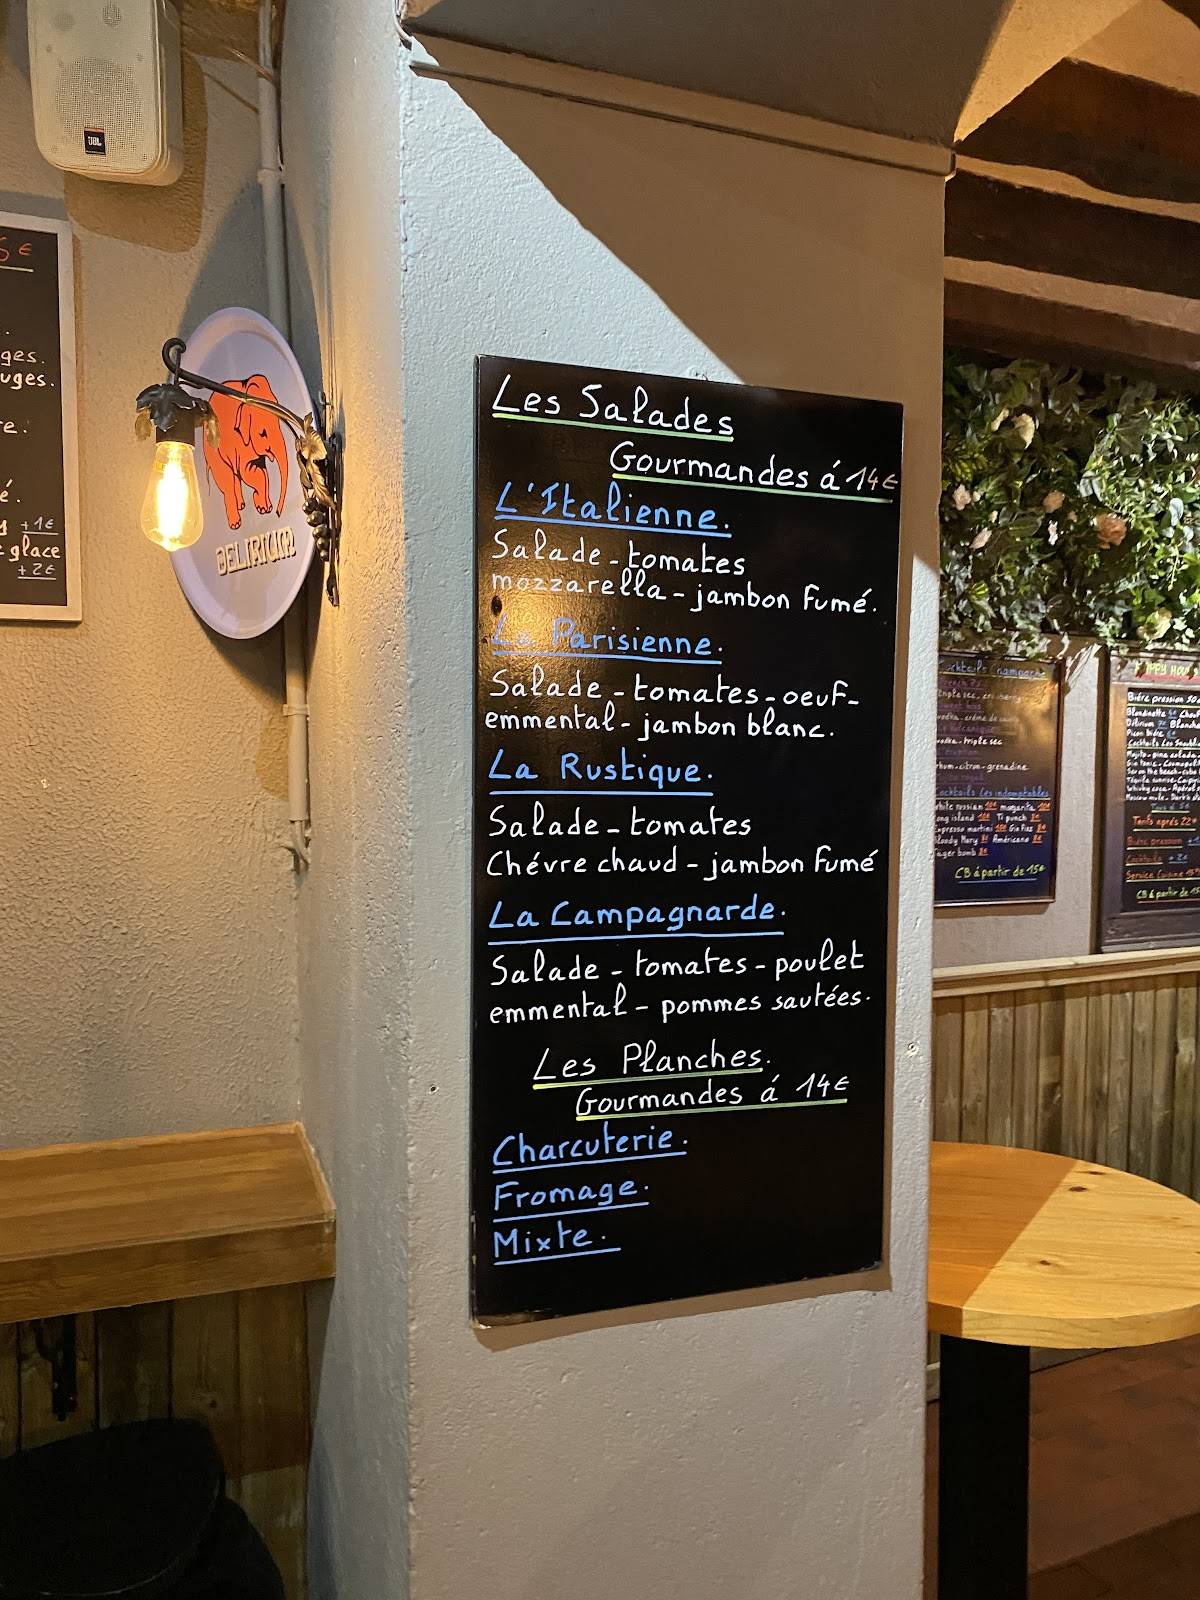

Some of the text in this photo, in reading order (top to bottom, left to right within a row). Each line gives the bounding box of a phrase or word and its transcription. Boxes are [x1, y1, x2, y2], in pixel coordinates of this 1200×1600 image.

[87, 136, 103, 147] JBL
[492, 373, 736, 437] Les Salades
[610, 441, 809, 490] Gourmandes
[846, 467, 898, 492] 14€
[495, 482, 731, 531] L'Italienne.
[9, 534, 61, 562] glace
[214, 525, 297, 577] DELIRIUM
[491, 528, 746, 577] Salade tomates
[491, 566, 668, 602] mozzarella
[689, 583, 791, 613] jambon
[552, 617, 723, 656] Parisienne.
[488, 668, 603, 699] Salade
[633, 672, 760, 706] tomates
[1152, 695, 1184, 705] pression
[484, 699, 836, 742] emmental jambon blanc.
[963, 734, 988, 746] triple
[488, 746, 713, 790] La Rustique.
[985, 760, 1030, 773] grenadine
[488, 801, 752, 838] Salade tomates
[936, 815, 949, 823] ong
[952, 811, 975, 822] island
[1005, 813, 1027, 823] punch
[486, 849, 588, 878] Chévre
[598, 845, 678, 874] chaud
[702, 845, 804, 882] jambon
[955, 867, 971, 879] CB
[982, 865, 1011, 879] partir
[1012, 865, 1025, 876] de
[488, 892, 787, 933] La Campagnarde.
[490, 939, 866, 987] Salade tomates poulet
[489, 981, 871, 1026] emmental pommes sautées.
[532, 1038, 772, 1082] Les Planches.
[575, 1079, 744, 1117] Gourmandes
[795, 1073, 850, 1099] 14€
[492, 1121, 688, 1167] Charcuterie.
[493, 1179, 650, 1212] Fromage.
[493, 1219, 607, 1258] Mixte.
